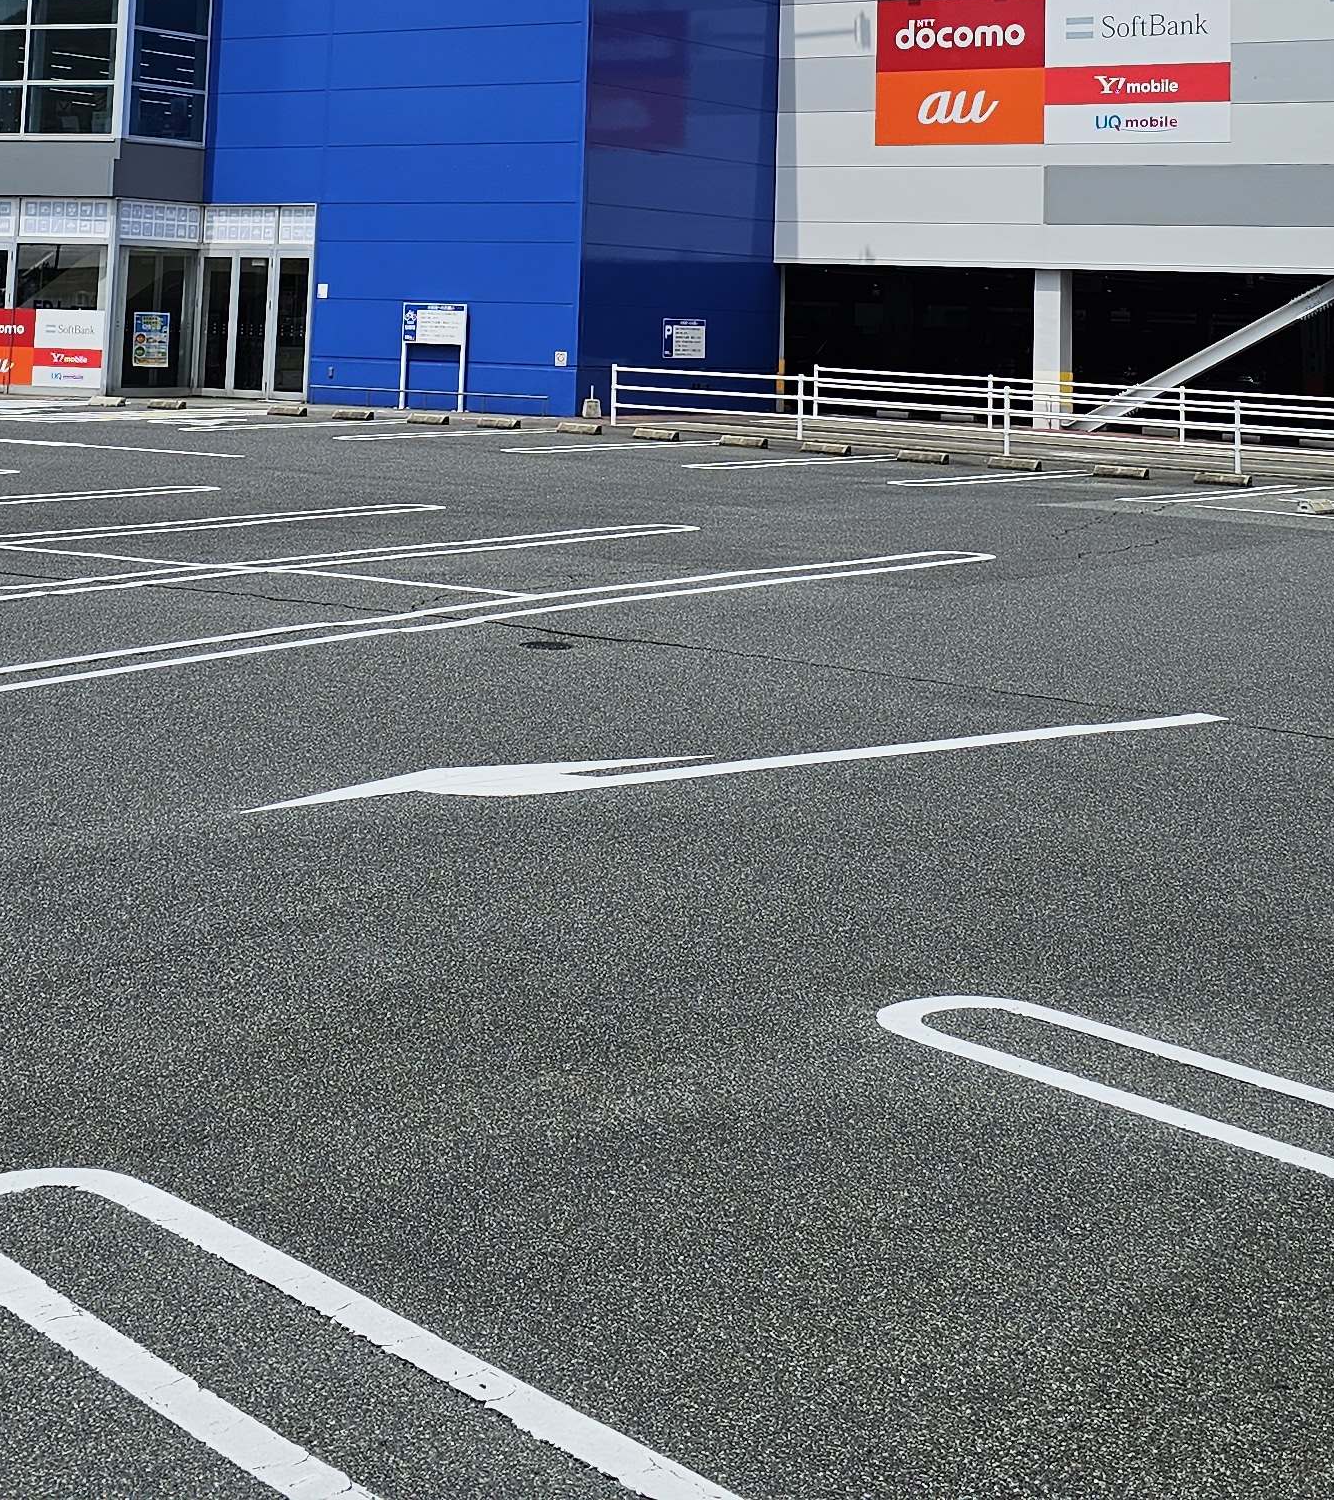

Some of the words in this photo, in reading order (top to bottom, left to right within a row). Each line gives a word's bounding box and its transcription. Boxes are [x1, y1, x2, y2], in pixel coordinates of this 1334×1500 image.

[916, 18, 936, 28] NTT
[1100, 13, 1209, 40] SoftBank
[894, 19, 1026, 50] docomo
[1126, 78, 1179, 94] mobile
[916, 89, 999, 125] au
[1095, 114, 1122, 131] UQ
[1125, 115, 1178, 128] mobile
[57, 324, 96, 335] SoftBank
